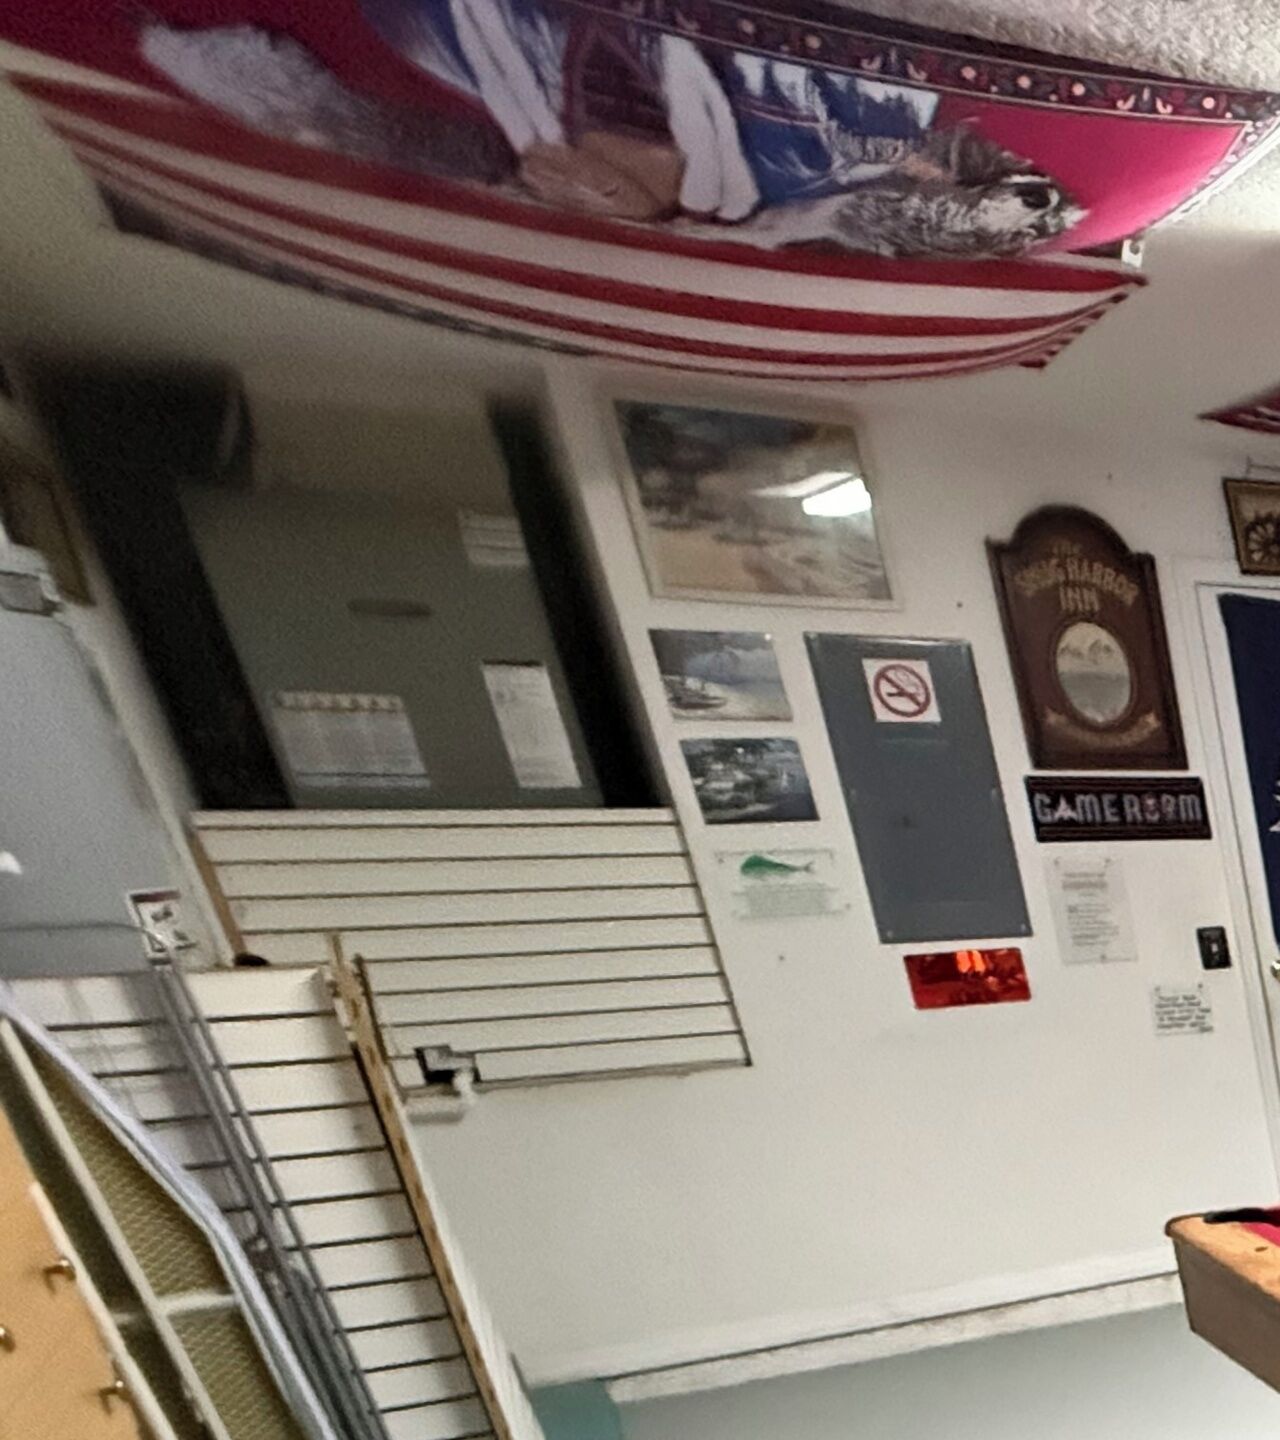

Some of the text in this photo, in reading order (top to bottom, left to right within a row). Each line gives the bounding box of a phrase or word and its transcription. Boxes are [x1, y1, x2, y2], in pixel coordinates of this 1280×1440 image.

[1059, 585, 1101, 613] INN
[1033, 791, 1202, 824] GAME ROOM
